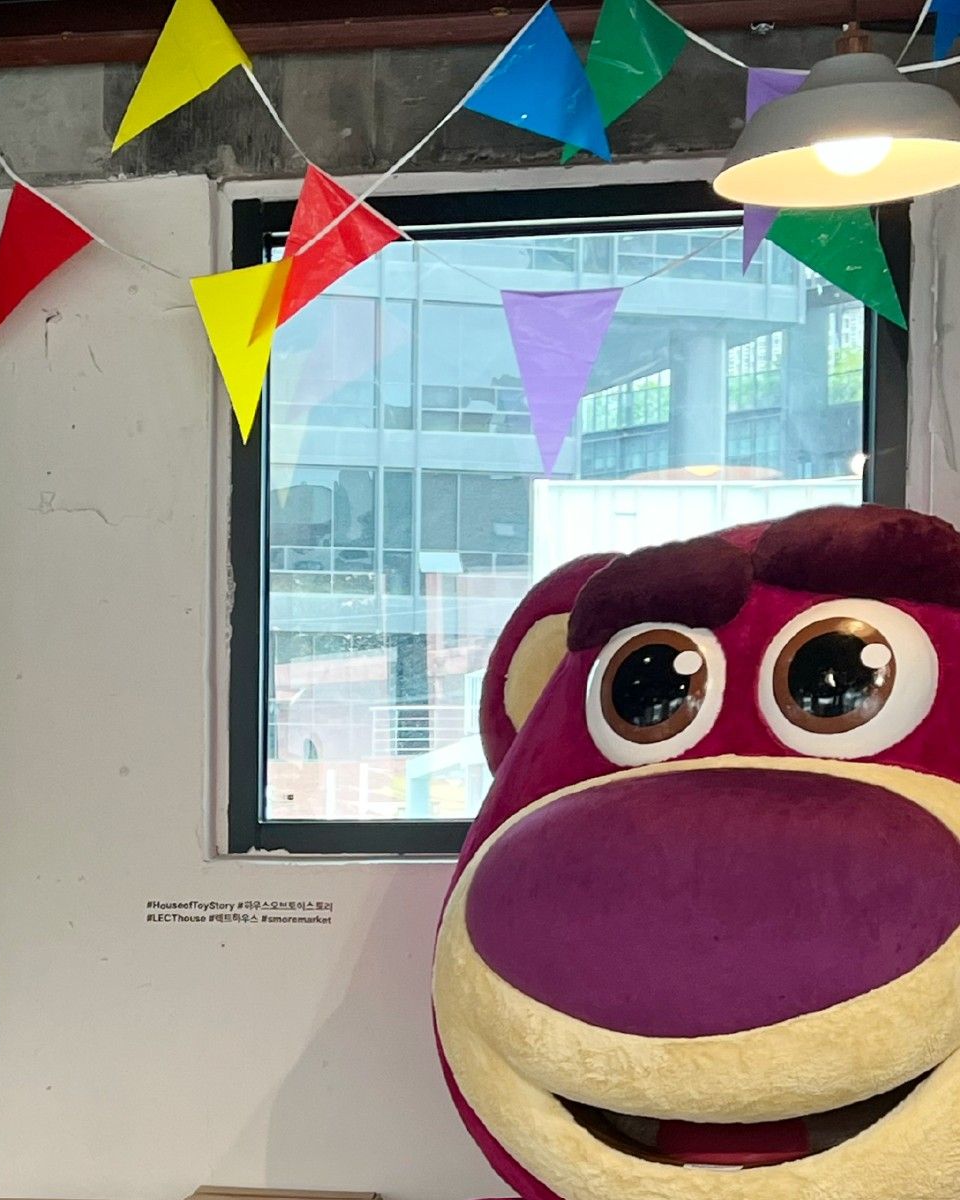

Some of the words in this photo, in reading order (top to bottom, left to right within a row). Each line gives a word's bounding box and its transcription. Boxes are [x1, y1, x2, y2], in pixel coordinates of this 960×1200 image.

[146, 900, 235, 912] #HouseofToyStory
[146, 913, 206, 923] #LECThouse
[261, 914, 332, 925] #smoremarket
